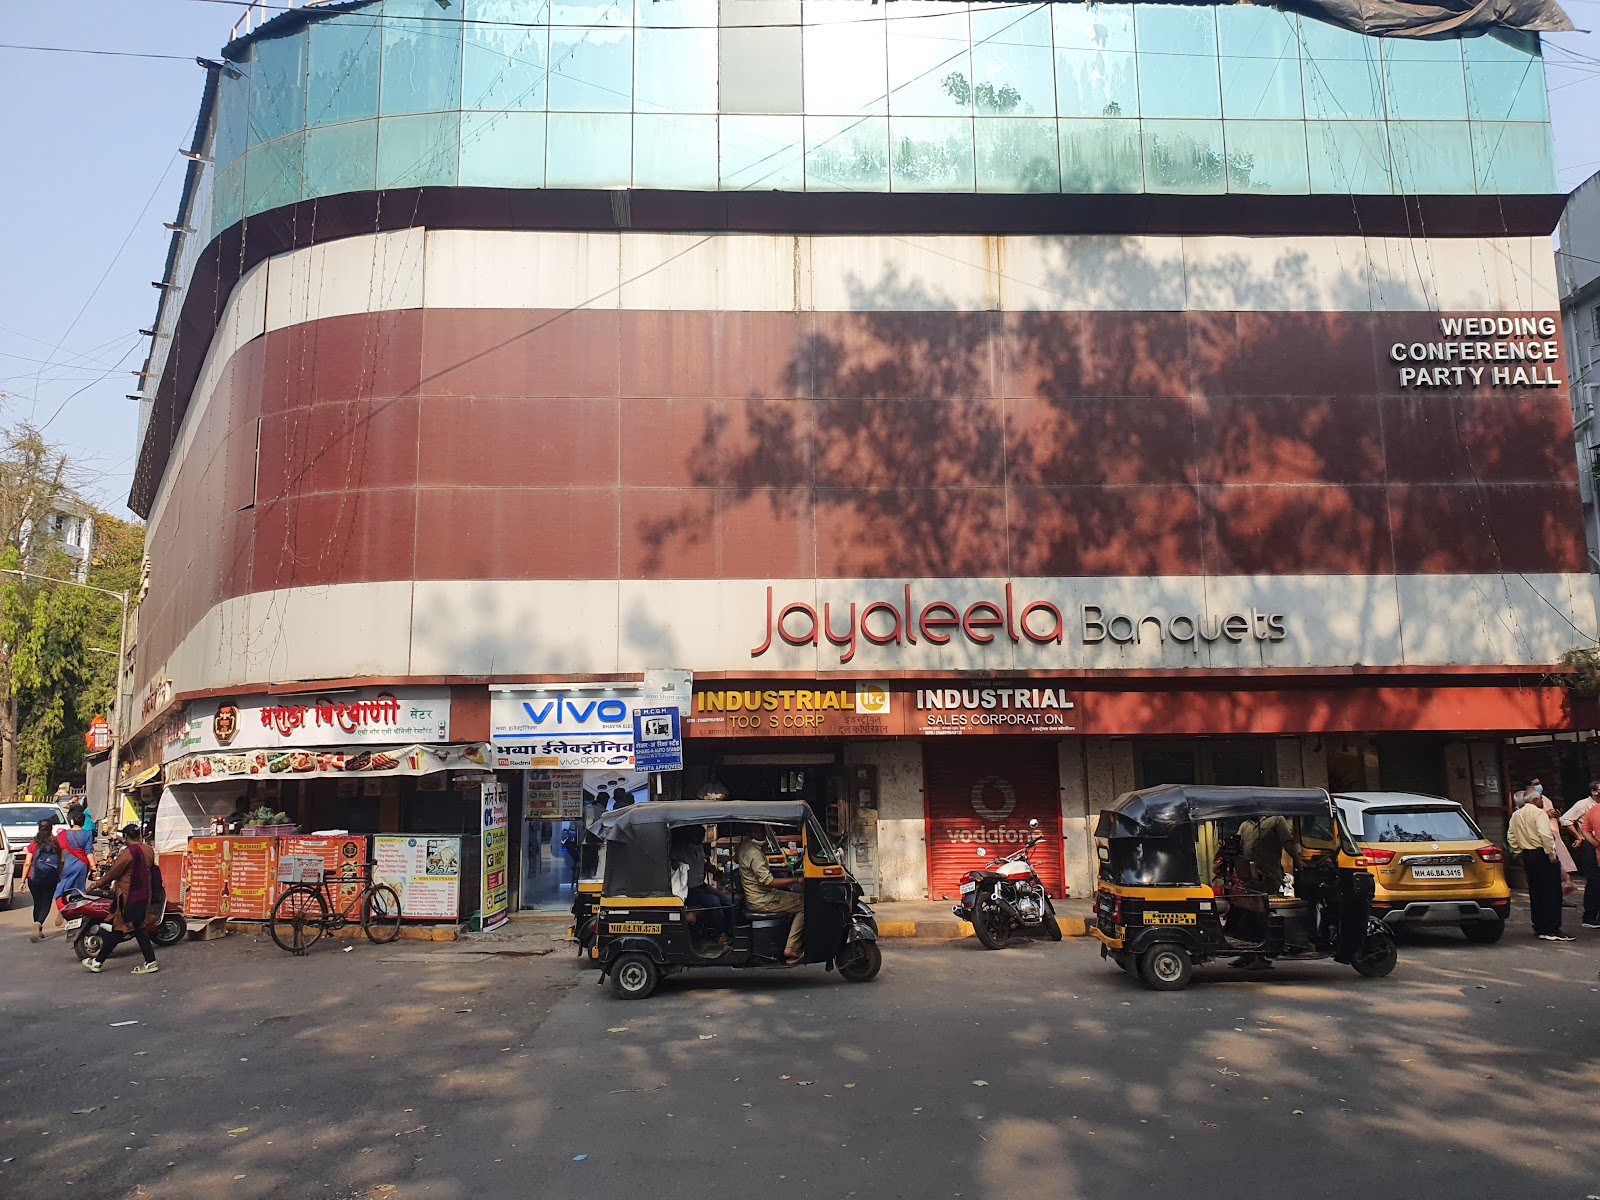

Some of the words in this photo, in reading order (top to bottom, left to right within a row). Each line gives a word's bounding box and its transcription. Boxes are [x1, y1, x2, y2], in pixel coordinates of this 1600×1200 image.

[1439, 317, 1556, 337] WEDDING
[1390, 341, 1559, 361] CONFERENCE
[1400, 367, 1485, 386] PARTY
[1491, 366, 1562, 385] HALL
[751, 582, 1064, 663] Jayaleela
[1081, 603, 1288, 654] Banquets
[523, 693, 627, 724] vivo
[698, 690, 855, 712] INDUSTRIAL
[916, 689, 1075, 710] INDUSTRIAL
[260, 704, 308, 737] मराठा
[410, 707, 433, 720] सेंटर
[783, 715, 825, 728] CORP
[927, 714, 968, 726] SALES
[559, 758, 580, 766] vivo
[580, 756, 606, 765] oppo
[946, 824, 1042, 844] vodafone
[428, 864, 455, 875] 25/-
